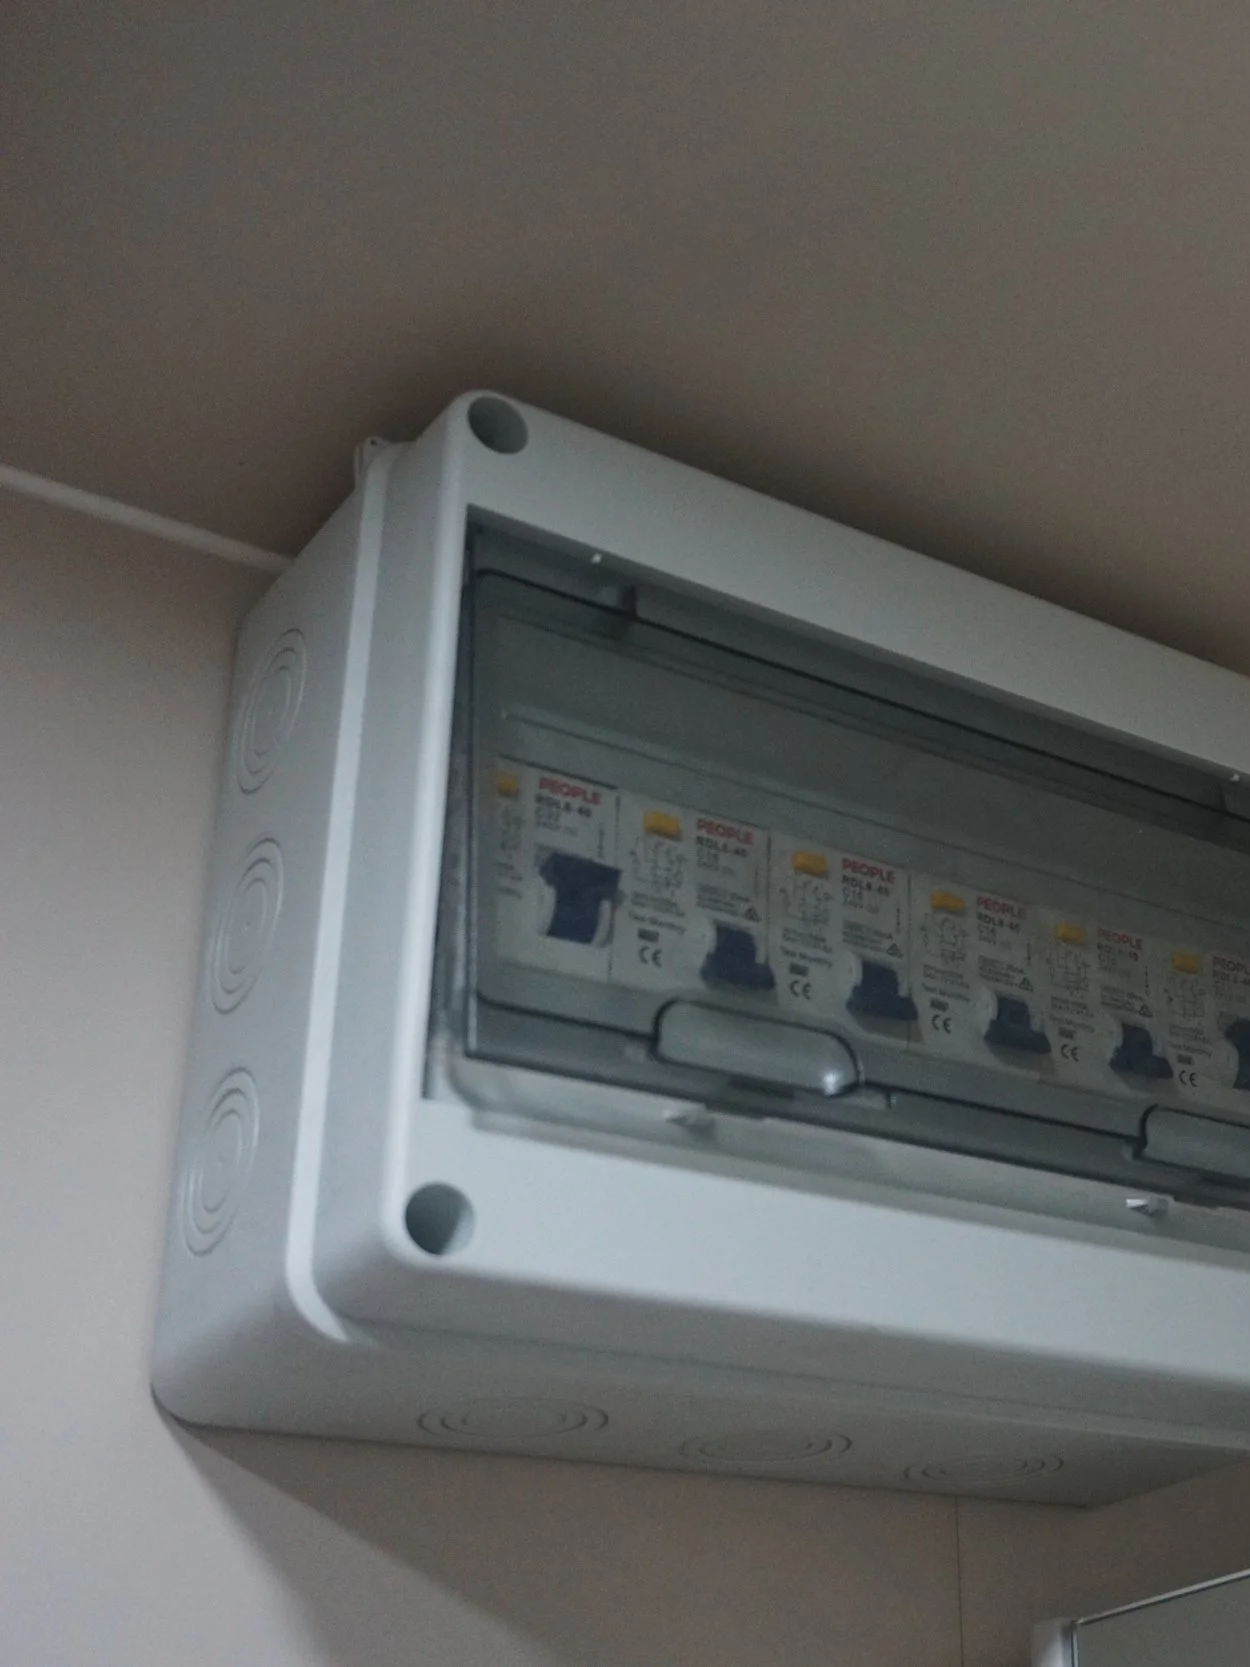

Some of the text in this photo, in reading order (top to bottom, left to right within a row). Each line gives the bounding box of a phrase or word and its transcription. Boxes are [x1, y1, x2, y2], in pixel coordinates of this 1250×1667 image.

[539, 777, 601, 805] PEOPLE
[697, 818, 753, 845] PEOPLE
[842, 858, 895, 884] PEOPLE
[977, 896, 1026, 919] PEOPLE
[1099, 928, 1142, 950] PEOPLE
